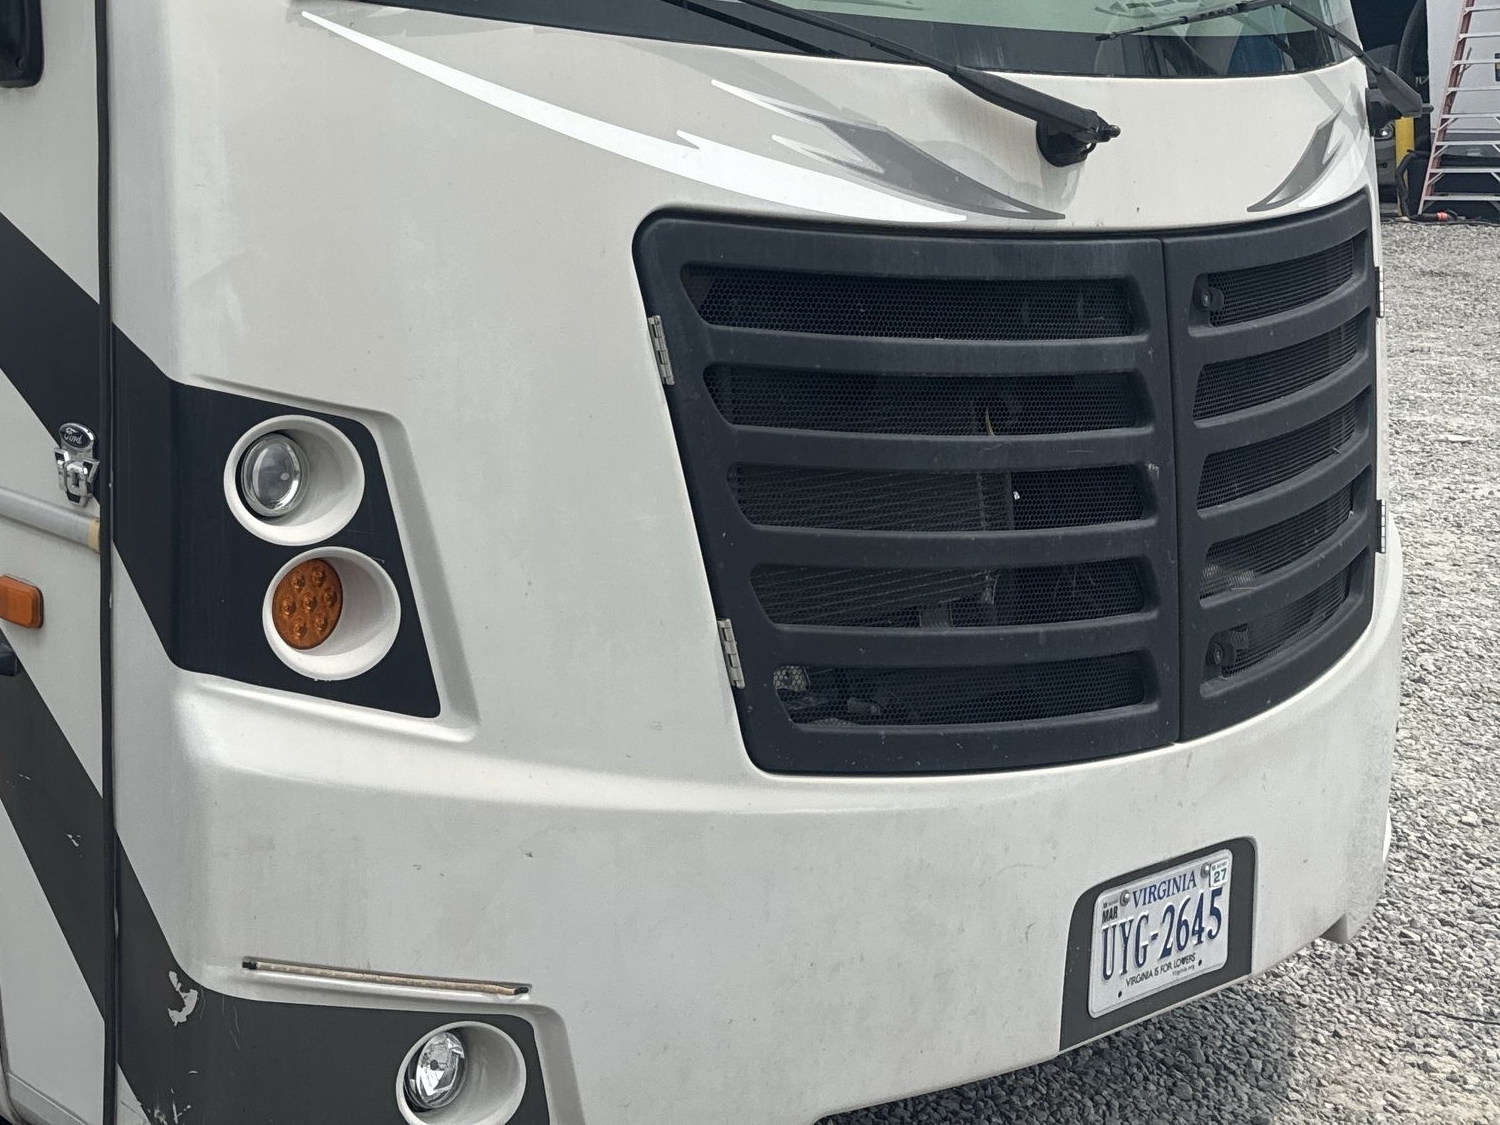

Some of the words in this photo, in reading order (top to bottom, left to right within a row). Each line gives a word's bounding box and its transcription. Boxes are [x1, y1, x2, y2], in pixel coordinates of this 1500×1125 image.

[64, 427, 83, 445] Ford
[1213, 867, 1227, 884] 27
[1132, 870, 1197, 908] VIRGINIA
[1102, 905, 1118, 925] MAR
[1101, 887, 1223, 981] UYG-2645
[1125, 969, 1153, 987] VIRGINIA
[1161, 961, 1173, 974] FOR
